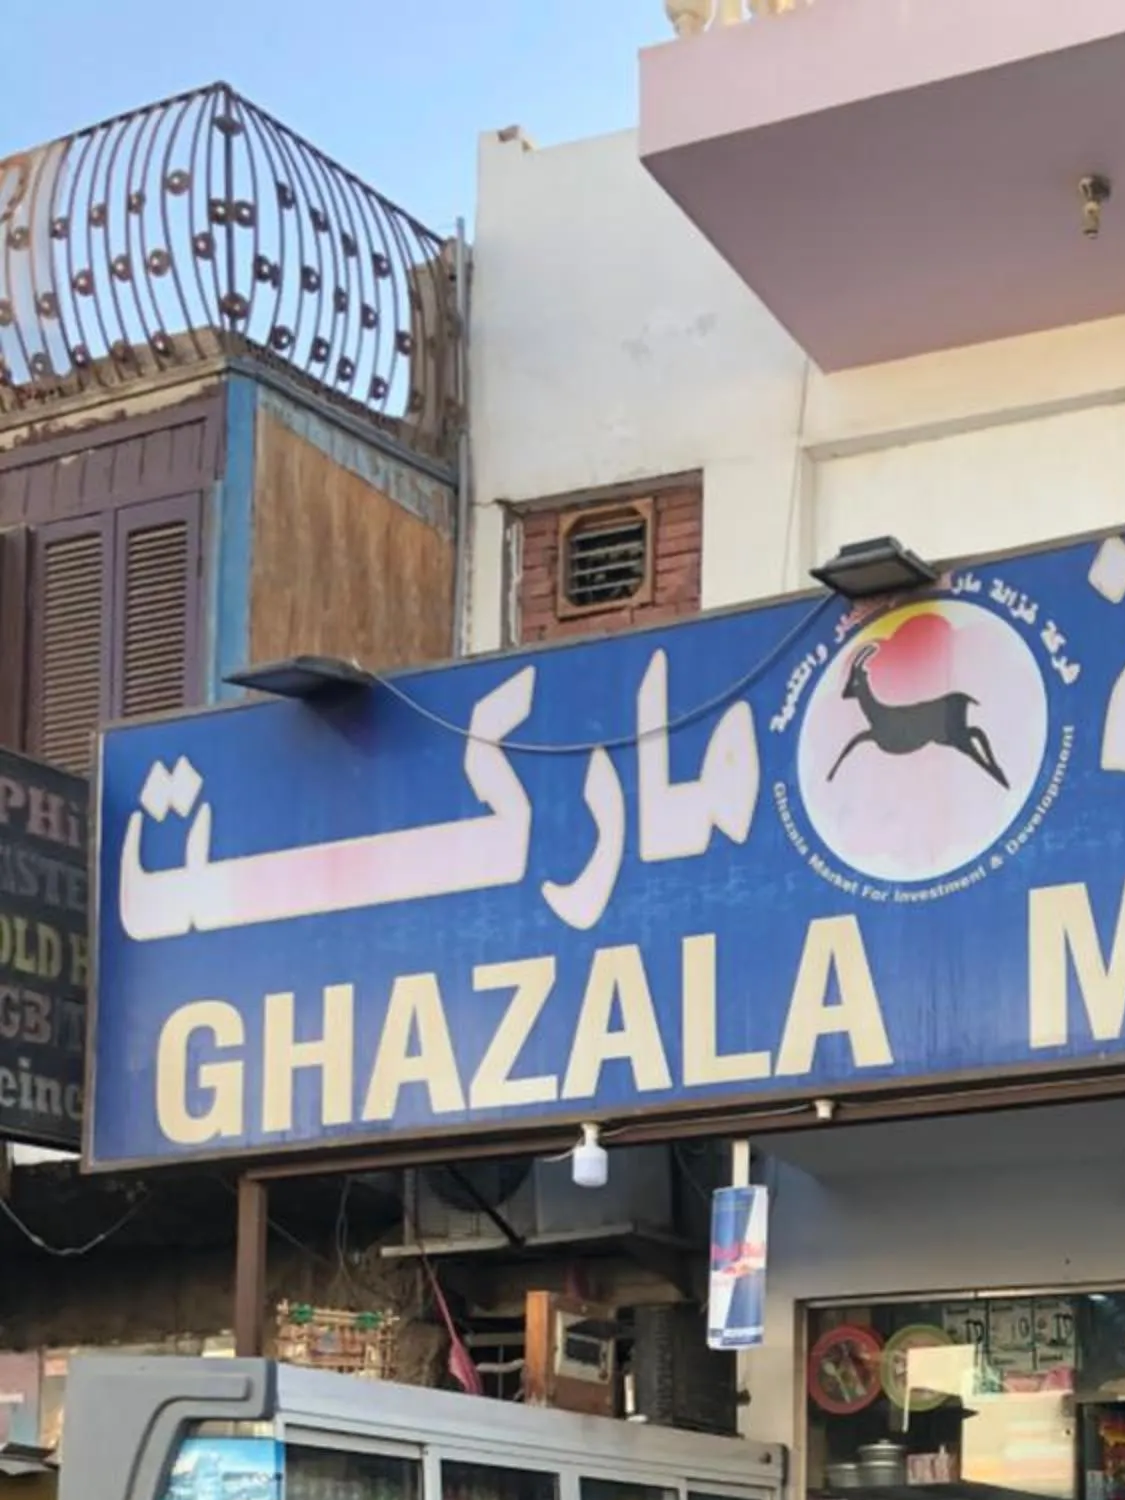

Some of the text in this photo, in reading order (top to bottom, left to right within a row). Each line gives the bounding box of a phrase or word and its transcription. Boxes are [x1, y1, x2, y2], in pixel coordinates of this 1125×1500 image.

[120, 648, 761, 941] ماركت
[808, 852, 859, 896] Market
[861, 883, 889, 902] For
[894, 864, 986, 903] Investment
[1005, 725, 1075, 855] Development
[155, 913, 896, 1145] GHAZALA
